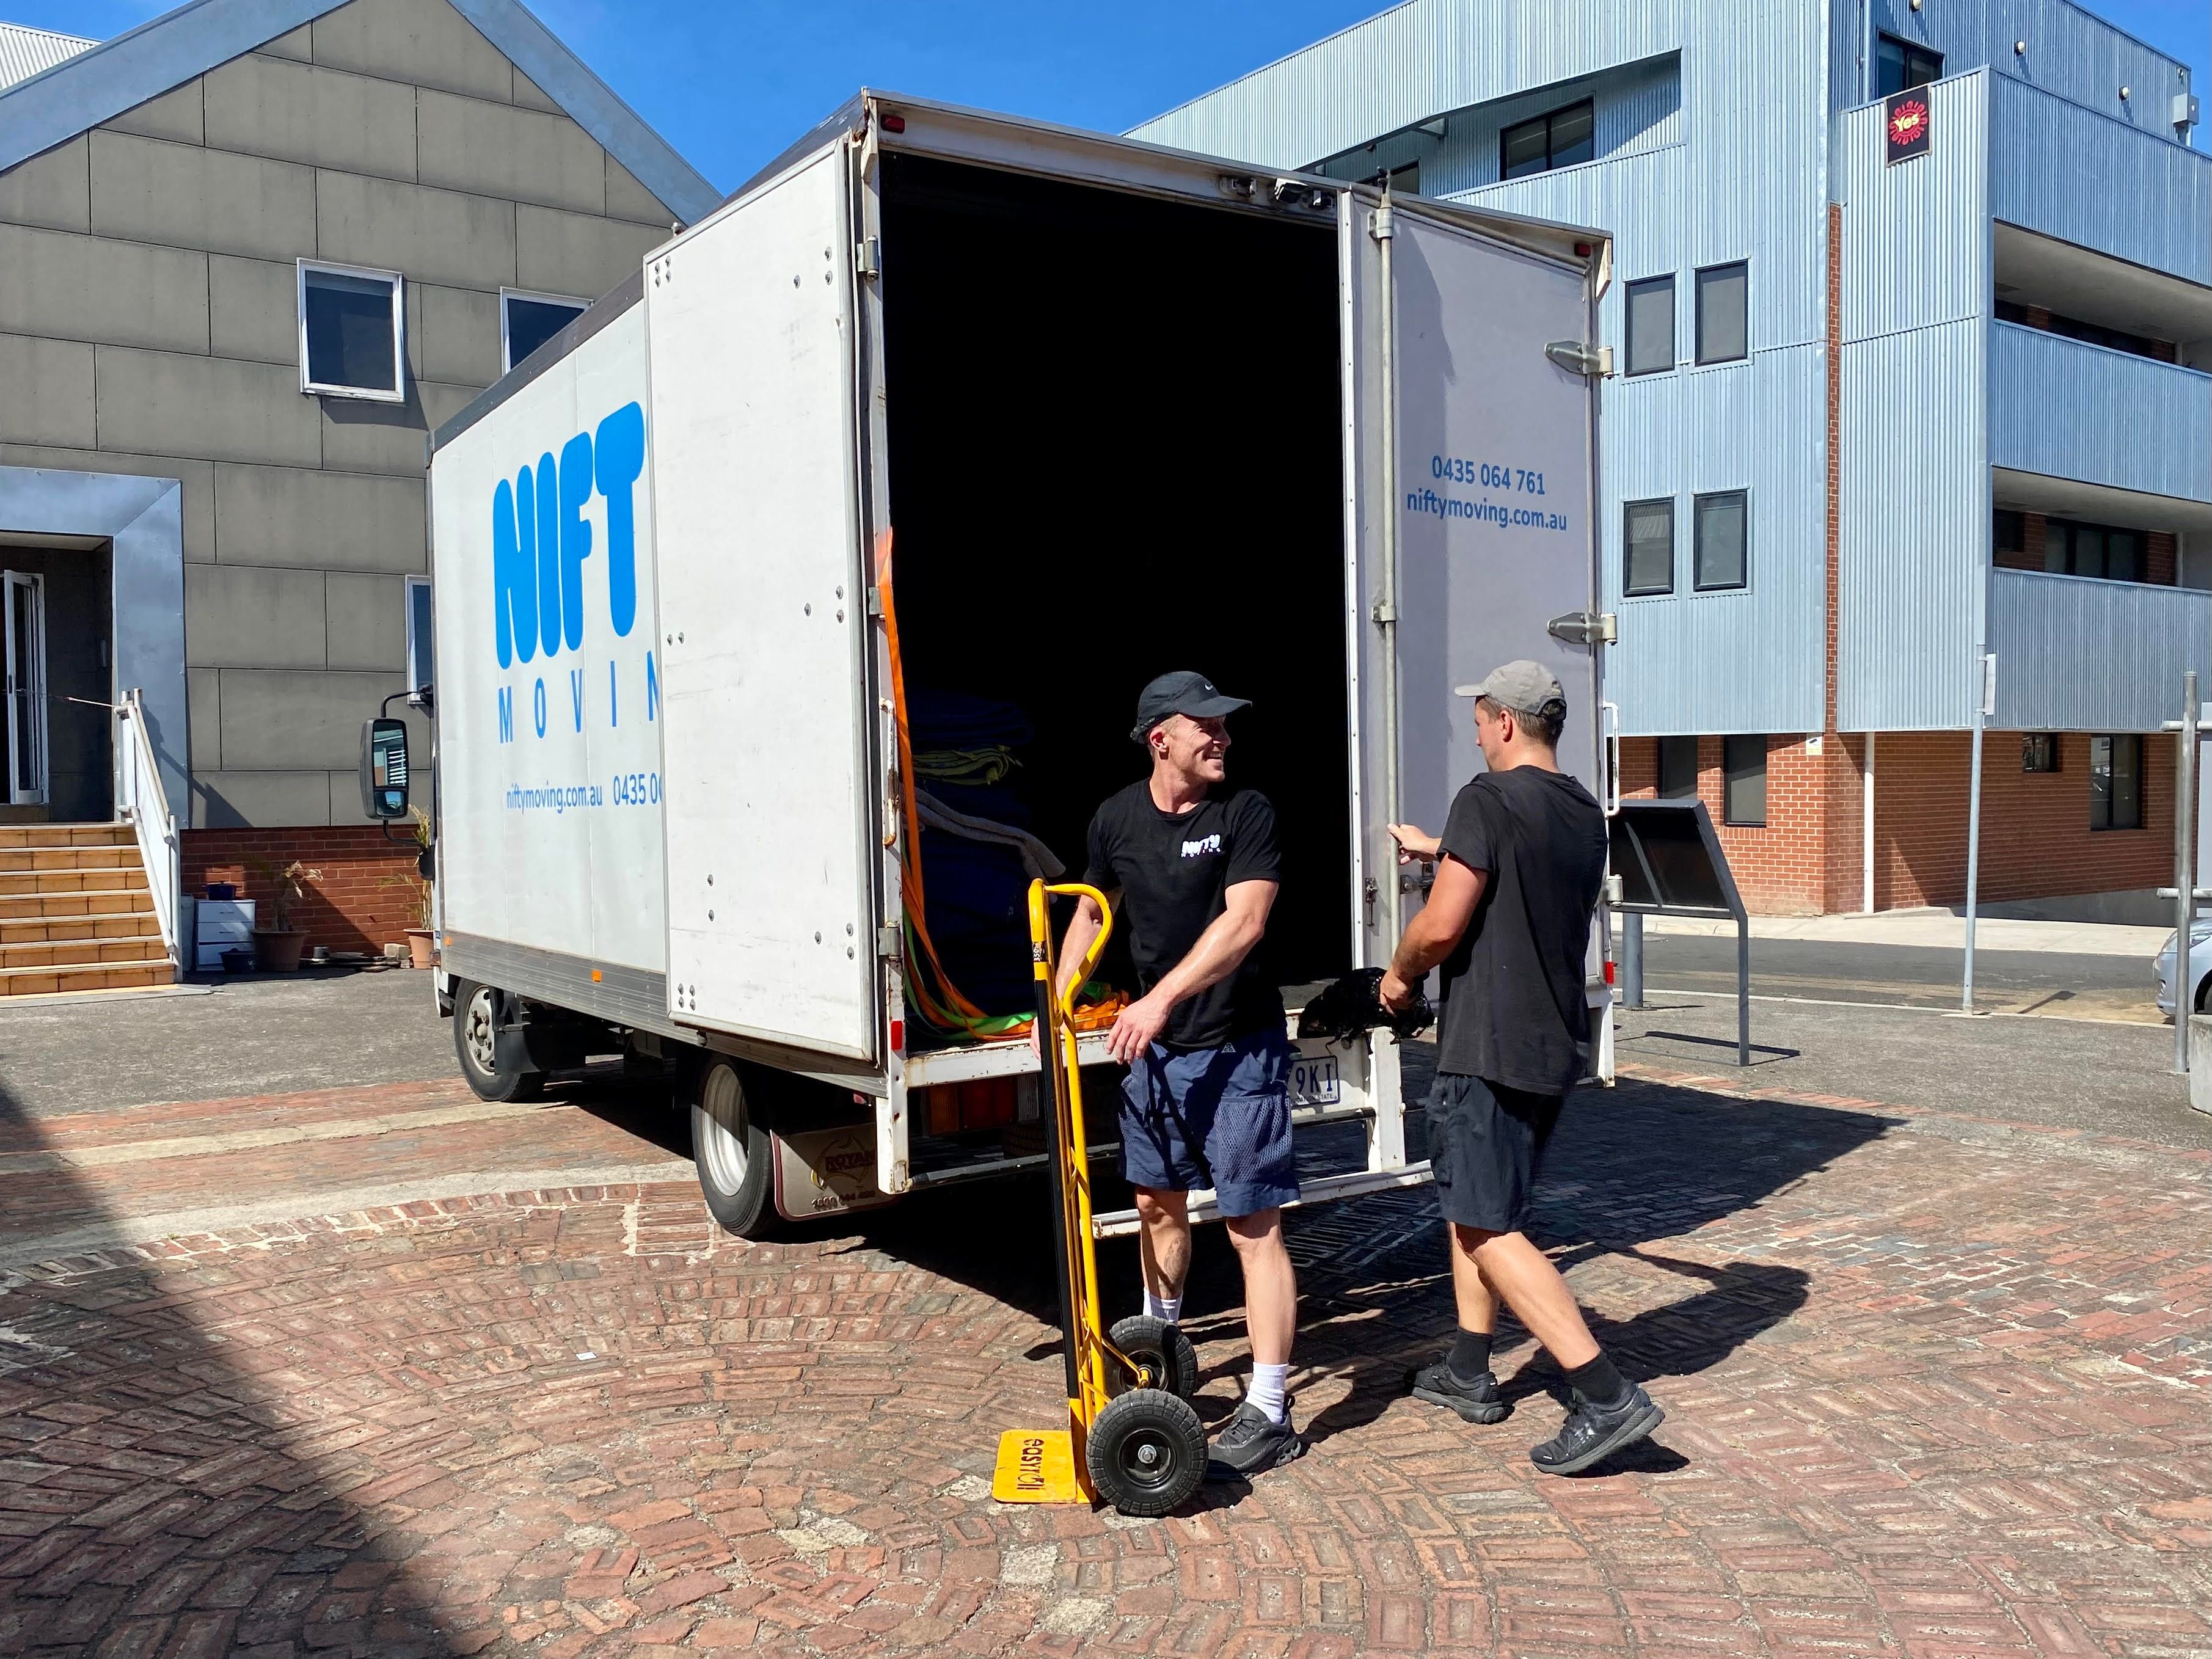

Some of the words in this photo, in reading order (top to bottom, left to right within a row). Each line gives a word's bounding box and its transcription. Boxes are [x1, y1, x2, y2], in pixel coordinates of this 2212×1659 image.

[1894, 113, 1919, 133] Yes
[1432, 455, 1475, 484] 0435
[1481, 463, 1511, 490] 064
[1516, 469, 1546, 495] 761
[1407, 487, 1567, 531] niftymoving.com.au
[493, 401, 651, 670] NIFT
[506, 779, 603, 815] niftymoving.com.au
[613, 773, 646, 806] 0435
[650, 772, 662, 804] 0
